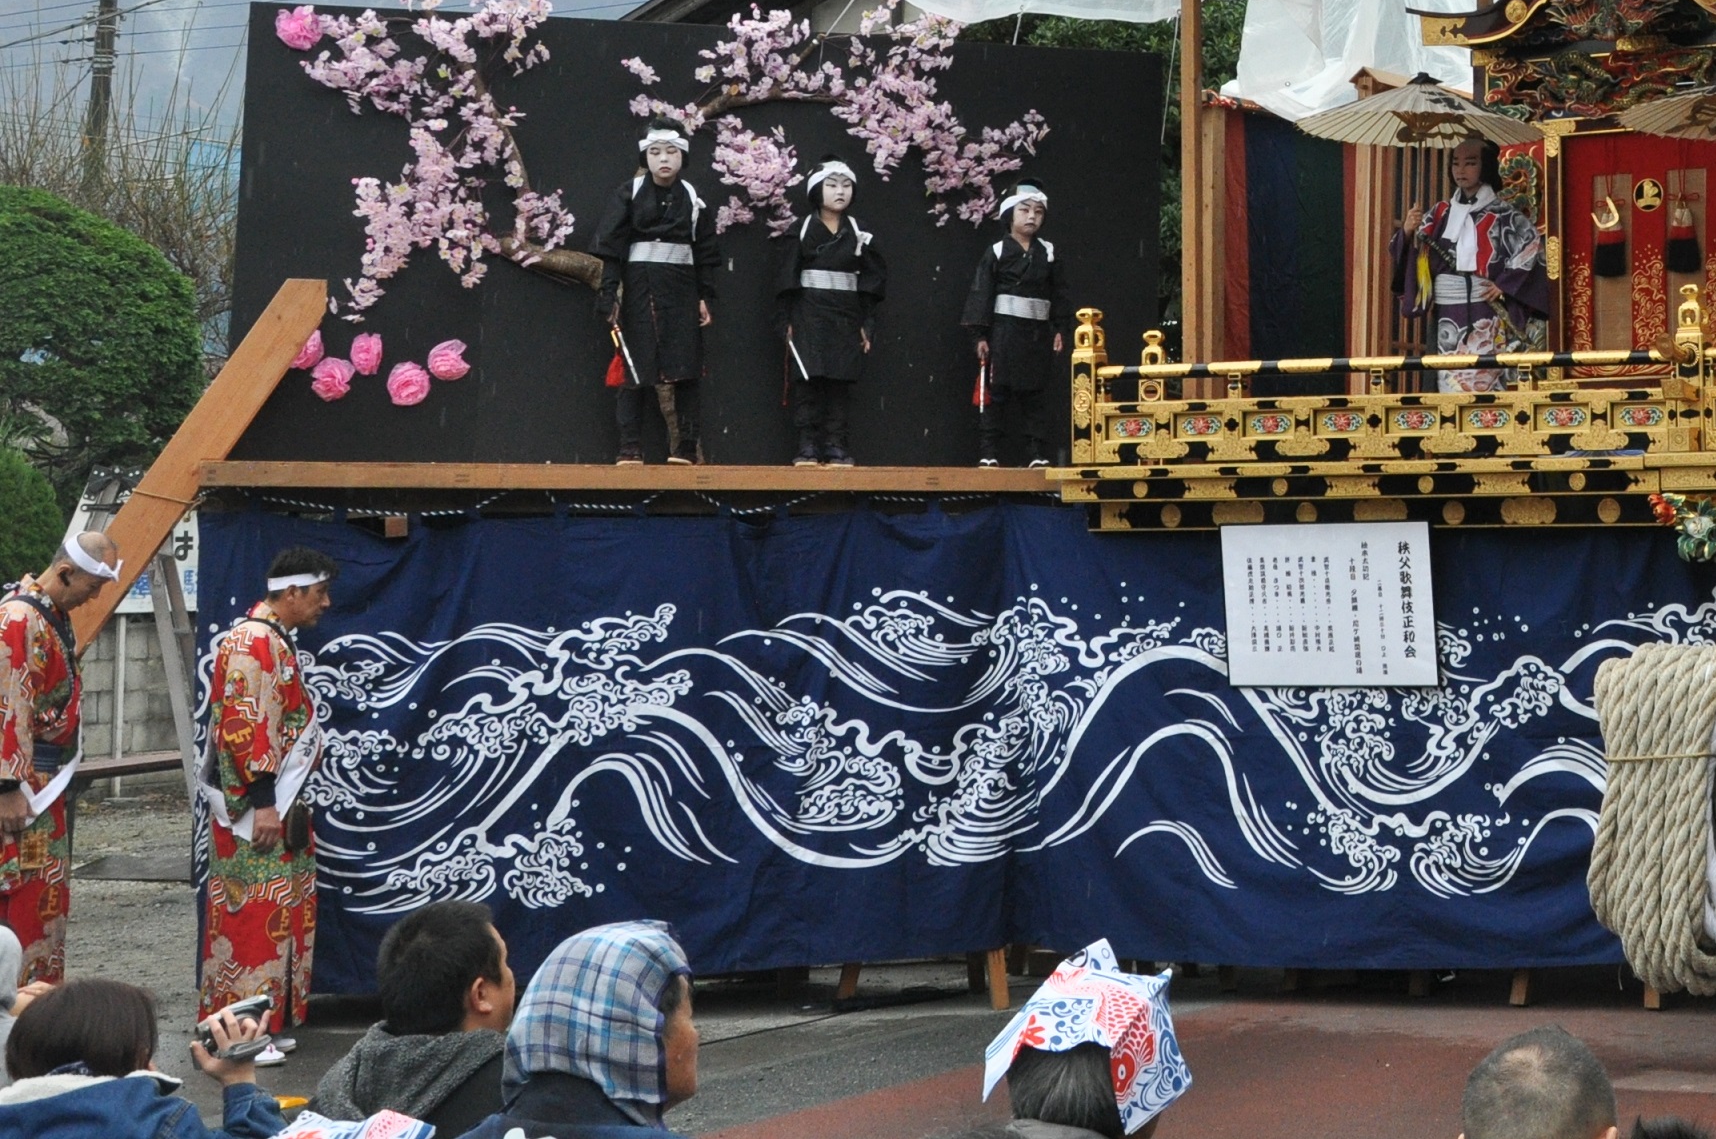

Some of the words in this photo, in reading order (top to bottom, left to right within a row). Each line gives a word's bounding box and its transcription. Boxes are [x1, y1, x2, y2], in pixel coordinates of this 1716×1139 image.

[1397, 540, 1417, 658] 秩父歌舞伎正和会
